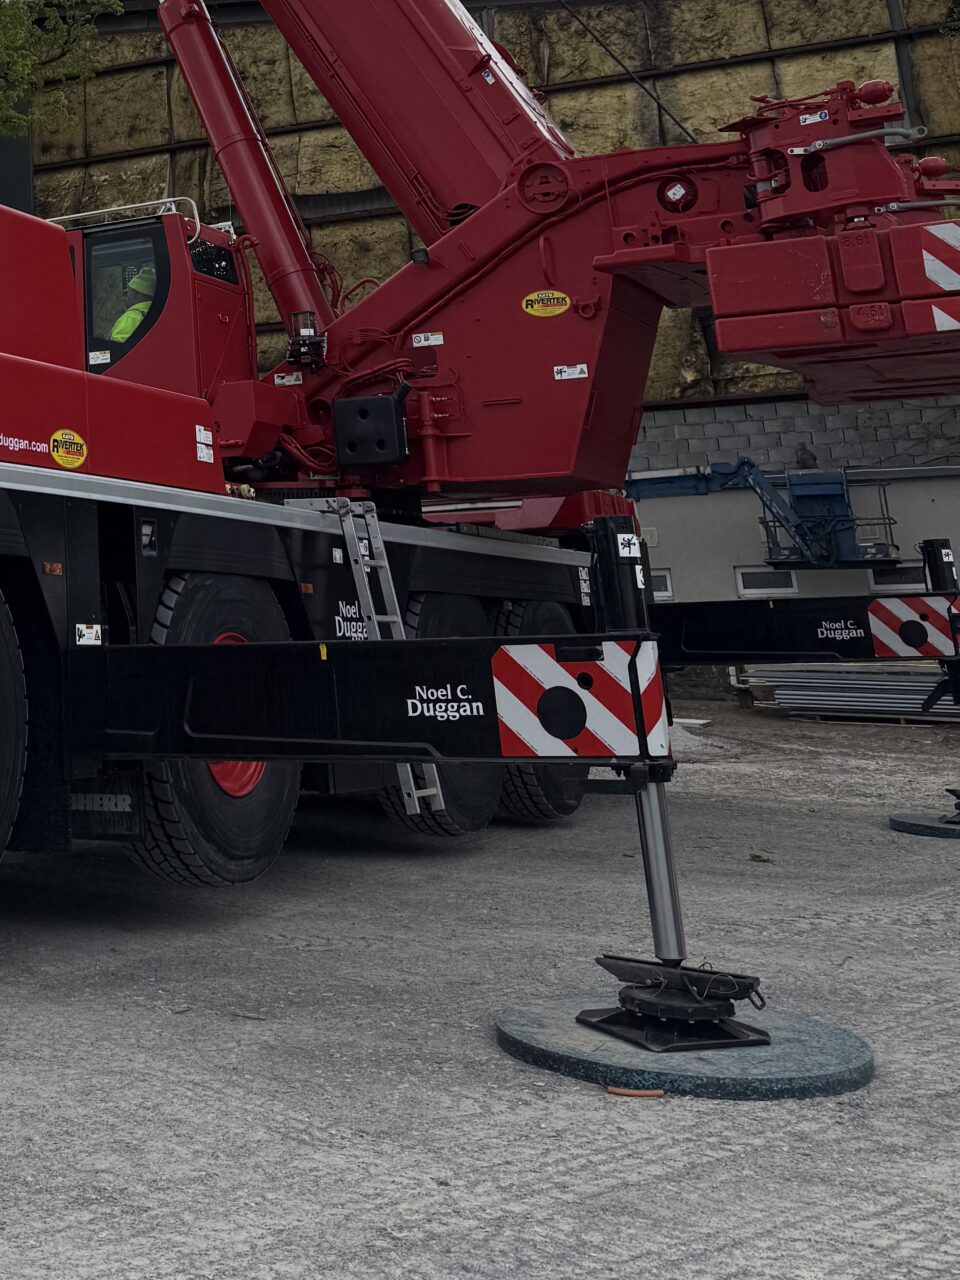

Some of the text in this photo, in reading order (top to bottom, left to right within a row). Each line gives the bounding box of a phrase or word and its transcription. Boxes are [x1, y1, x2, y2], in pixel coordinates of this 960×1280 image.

[338, 601, 359, 618] Noel
[335, 616, 368, 641] Dugga
[822, 620, 857, 629] Noel C.
[817, 628, 865, 640] Duggan
[415, 684, 473, 700] Noel C.
[406, 699, 485, 721] Duggan
